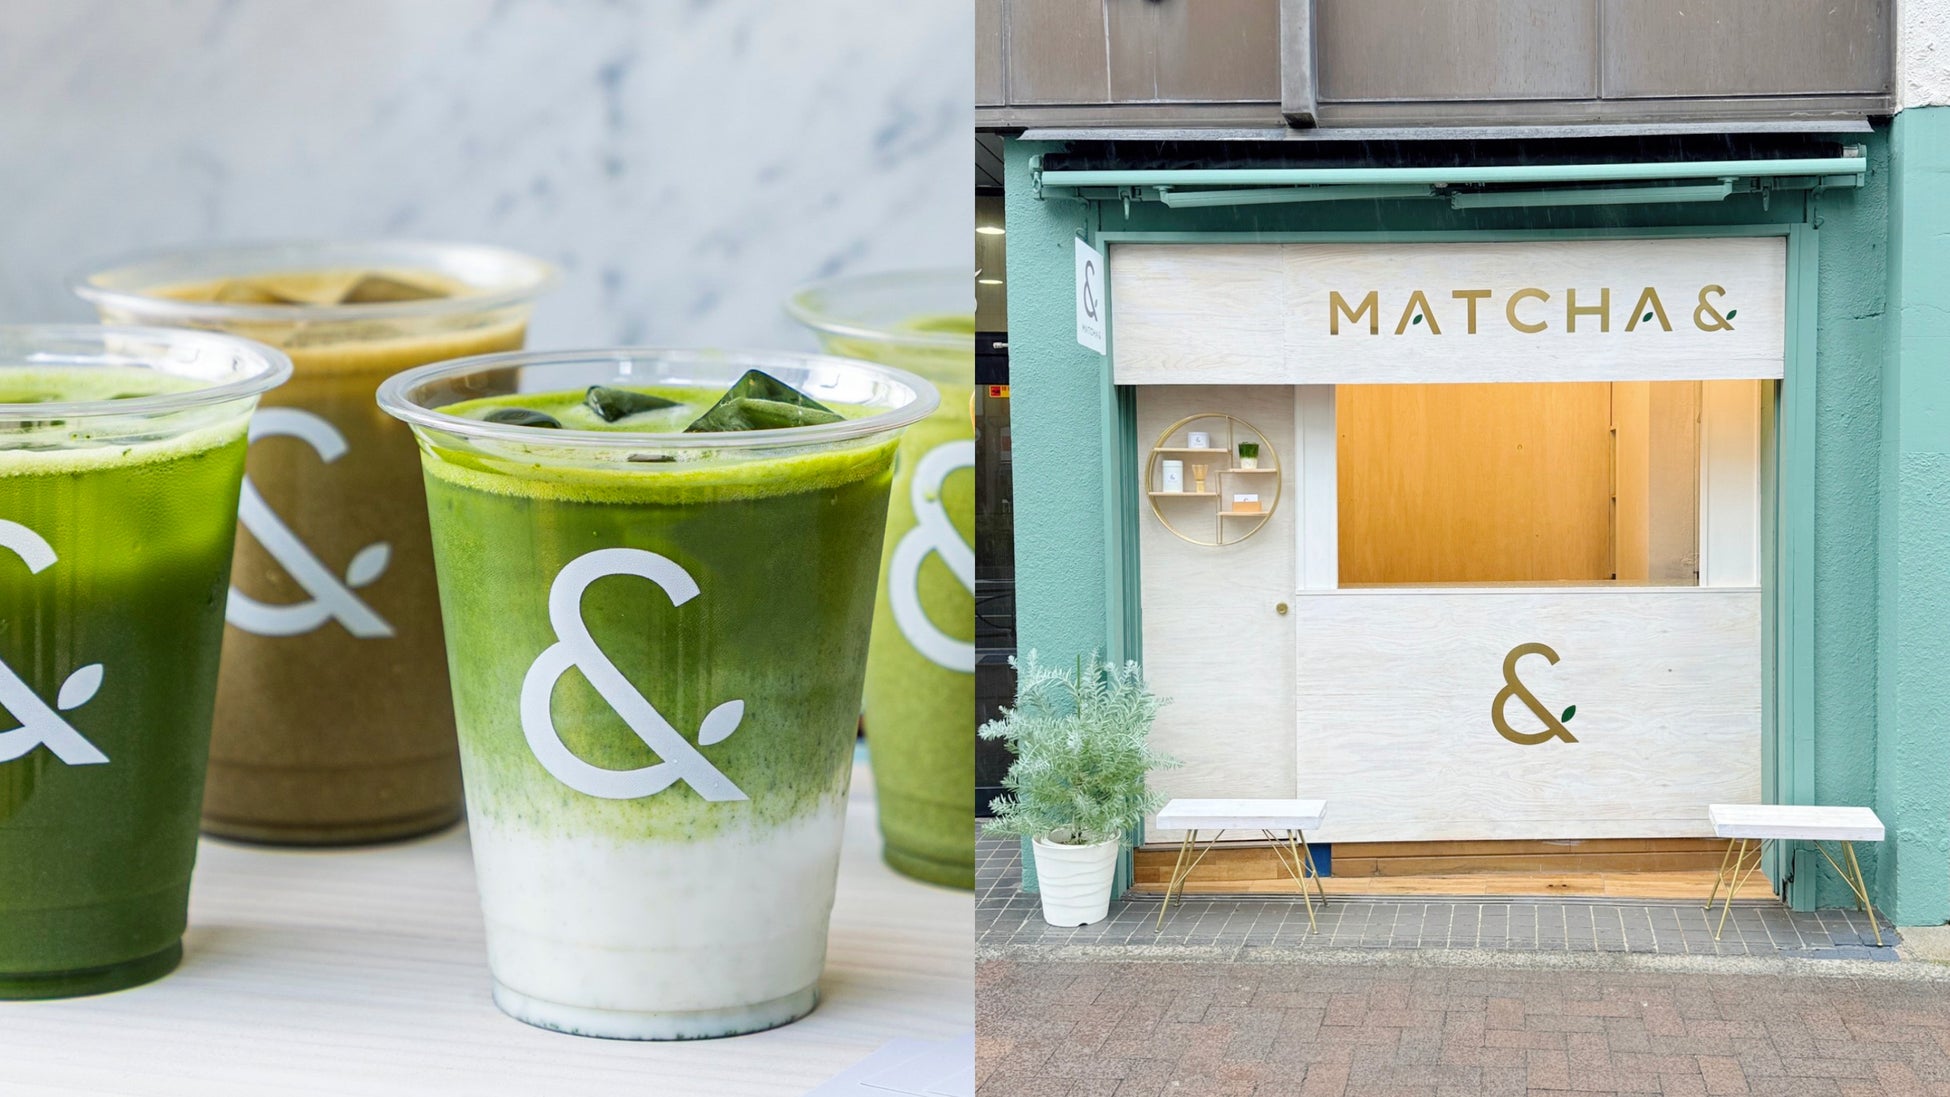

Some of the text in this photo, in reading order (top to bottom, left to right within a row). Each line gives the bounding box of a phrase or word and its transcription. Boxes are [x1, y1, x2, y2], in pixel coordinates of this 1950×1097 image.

[1083, 260, 1098, 322] &
[520, 547, 750, 802] &
[1491, 642, 1580, 746] &
